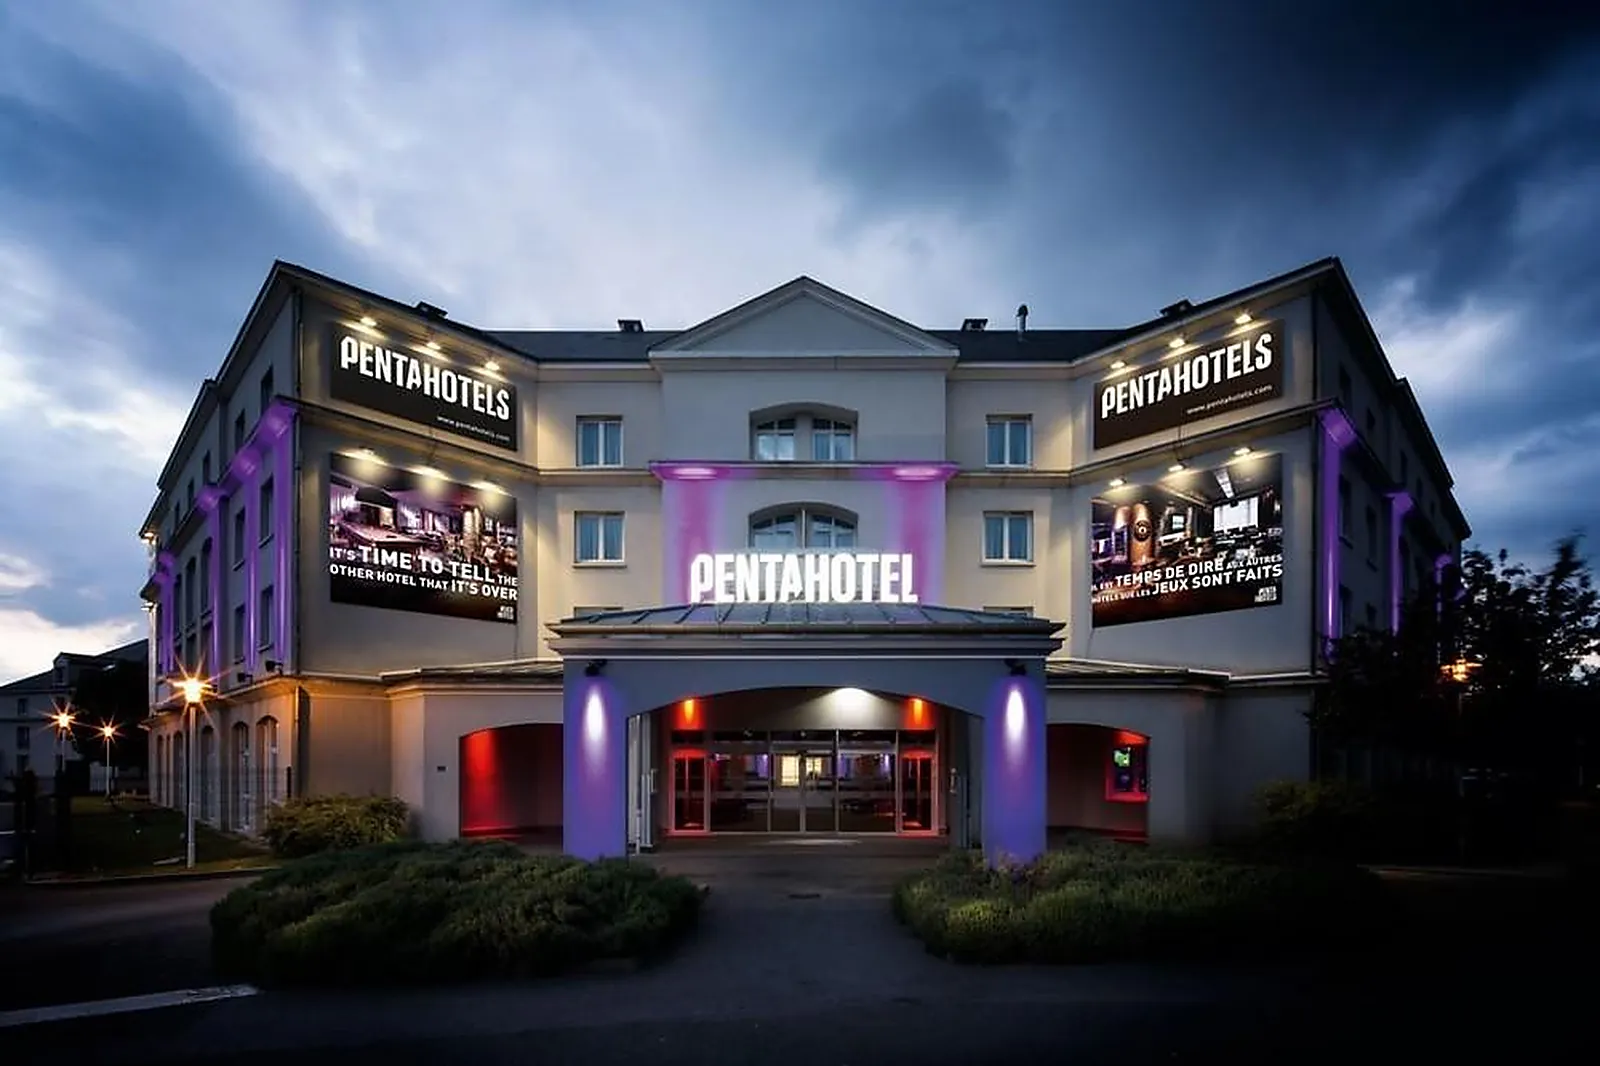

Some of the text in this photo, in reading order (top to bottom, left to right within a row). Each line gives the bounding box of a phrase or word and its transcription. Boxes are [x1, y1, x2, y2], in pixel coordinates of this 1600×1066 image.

[340, 336, 510, 420] PENTAHOTELS
[1101, 333, 1273, 419] PENTAHOTELS
[1186, 385, 1273, 415] www.pentahotels.com
[329, 545, 518, 587] IT'S TIME TO TELL THE
[329, 563, 518, 601] OTHER HOTEL THAT IT'S OVER
[690, 553, 918, 604] PENTAHOTEL
[1115, 569, 1162, 587] TEMPS
[1165, 565, 1185, 580] DE
[1188, 558, 1224, 576] DIRE
[1246, 554, 1283, 567] AUTRES
[1152, 578, 1189, 595] JEUX
[1192, 571, 1233, 589] SONT
[1236, 563, 1283, 583] FAITS
